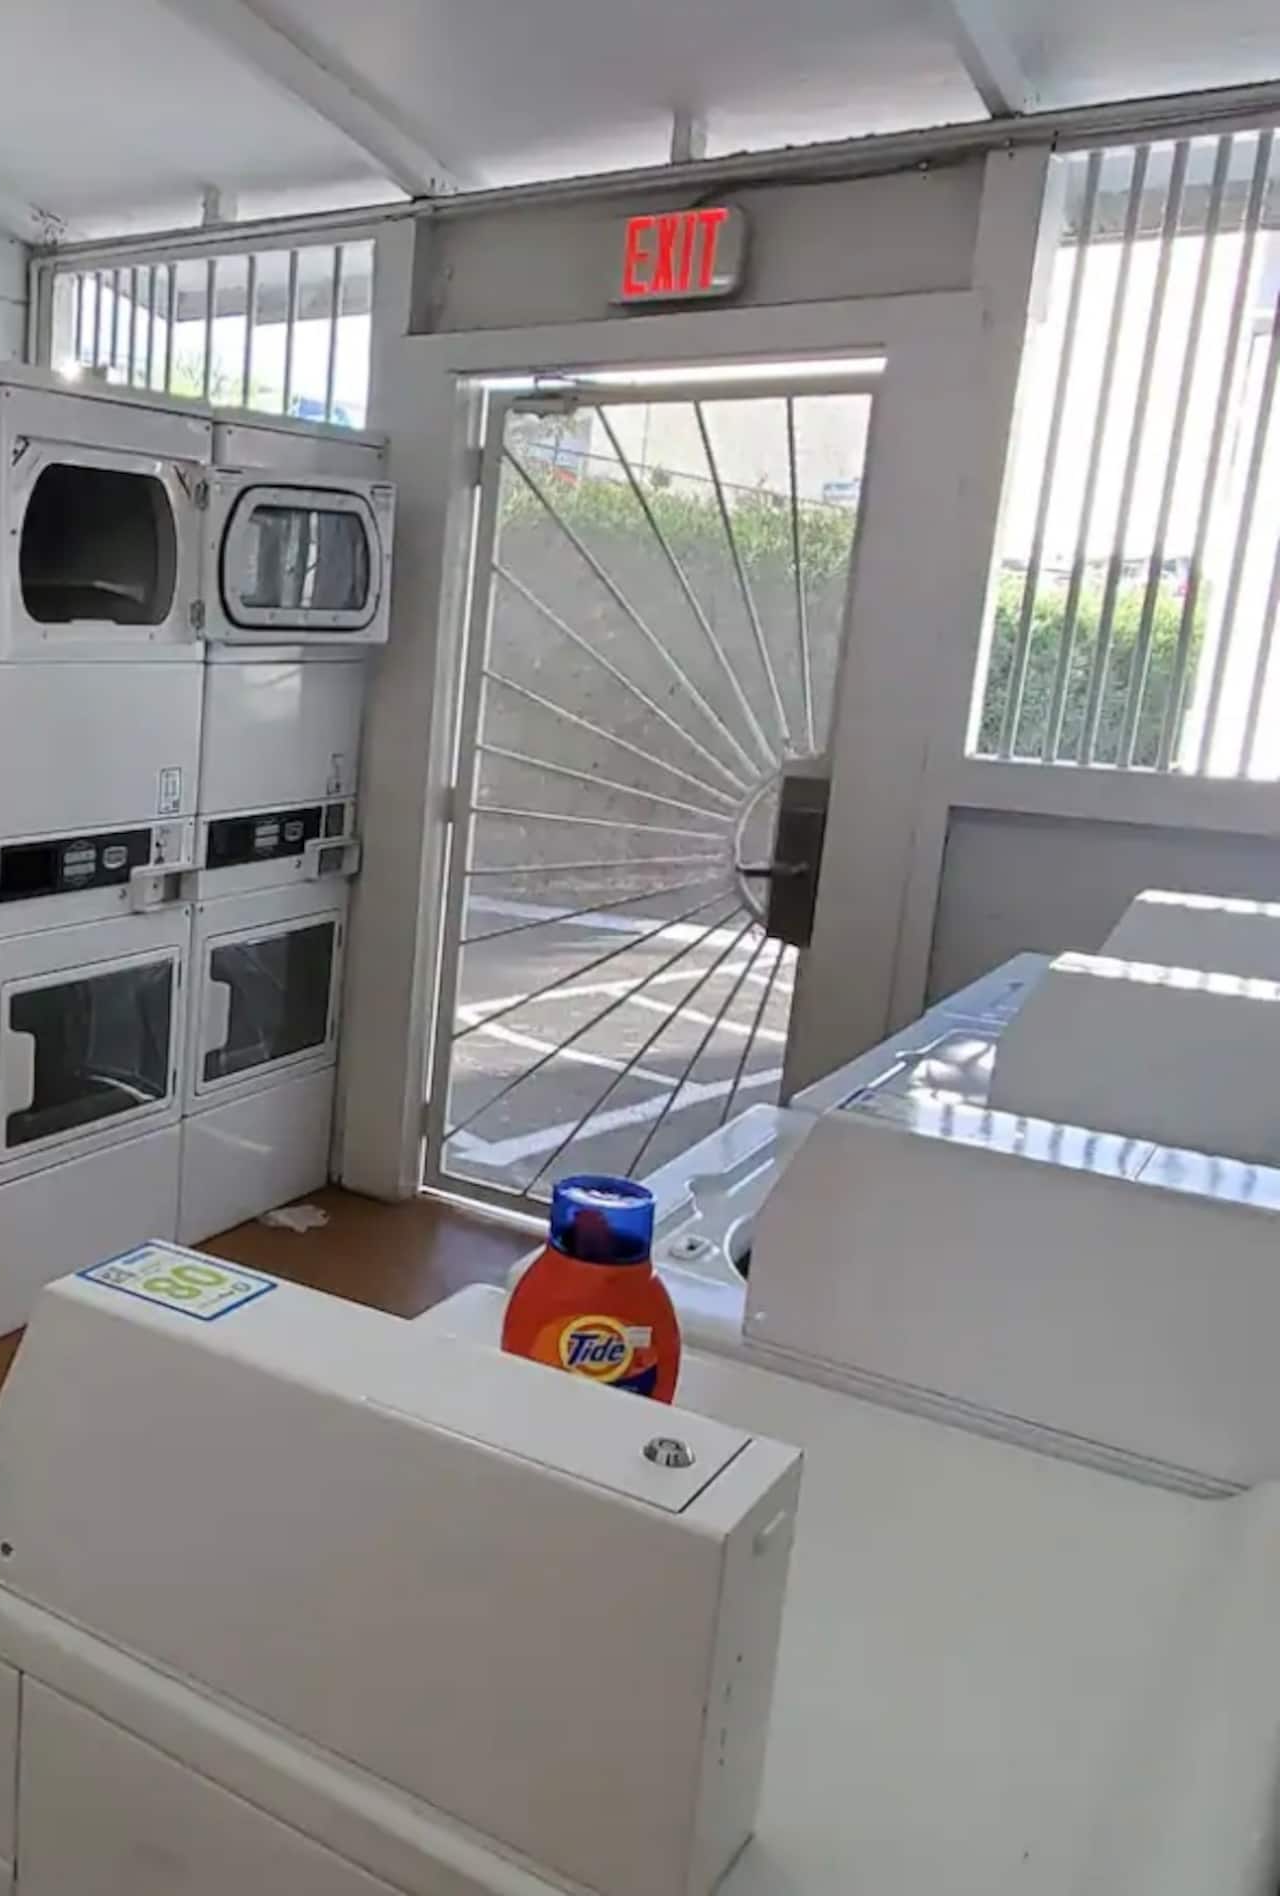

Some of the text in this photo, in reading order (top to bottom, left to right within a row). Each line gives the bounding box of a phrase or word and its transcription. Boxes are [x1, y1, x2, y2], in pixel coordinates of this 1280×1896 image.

[623, 208, 728, 297] EXIT
[142, 1265, 227, 1300] 08
[567, 1333, 625, 1366] Tide
